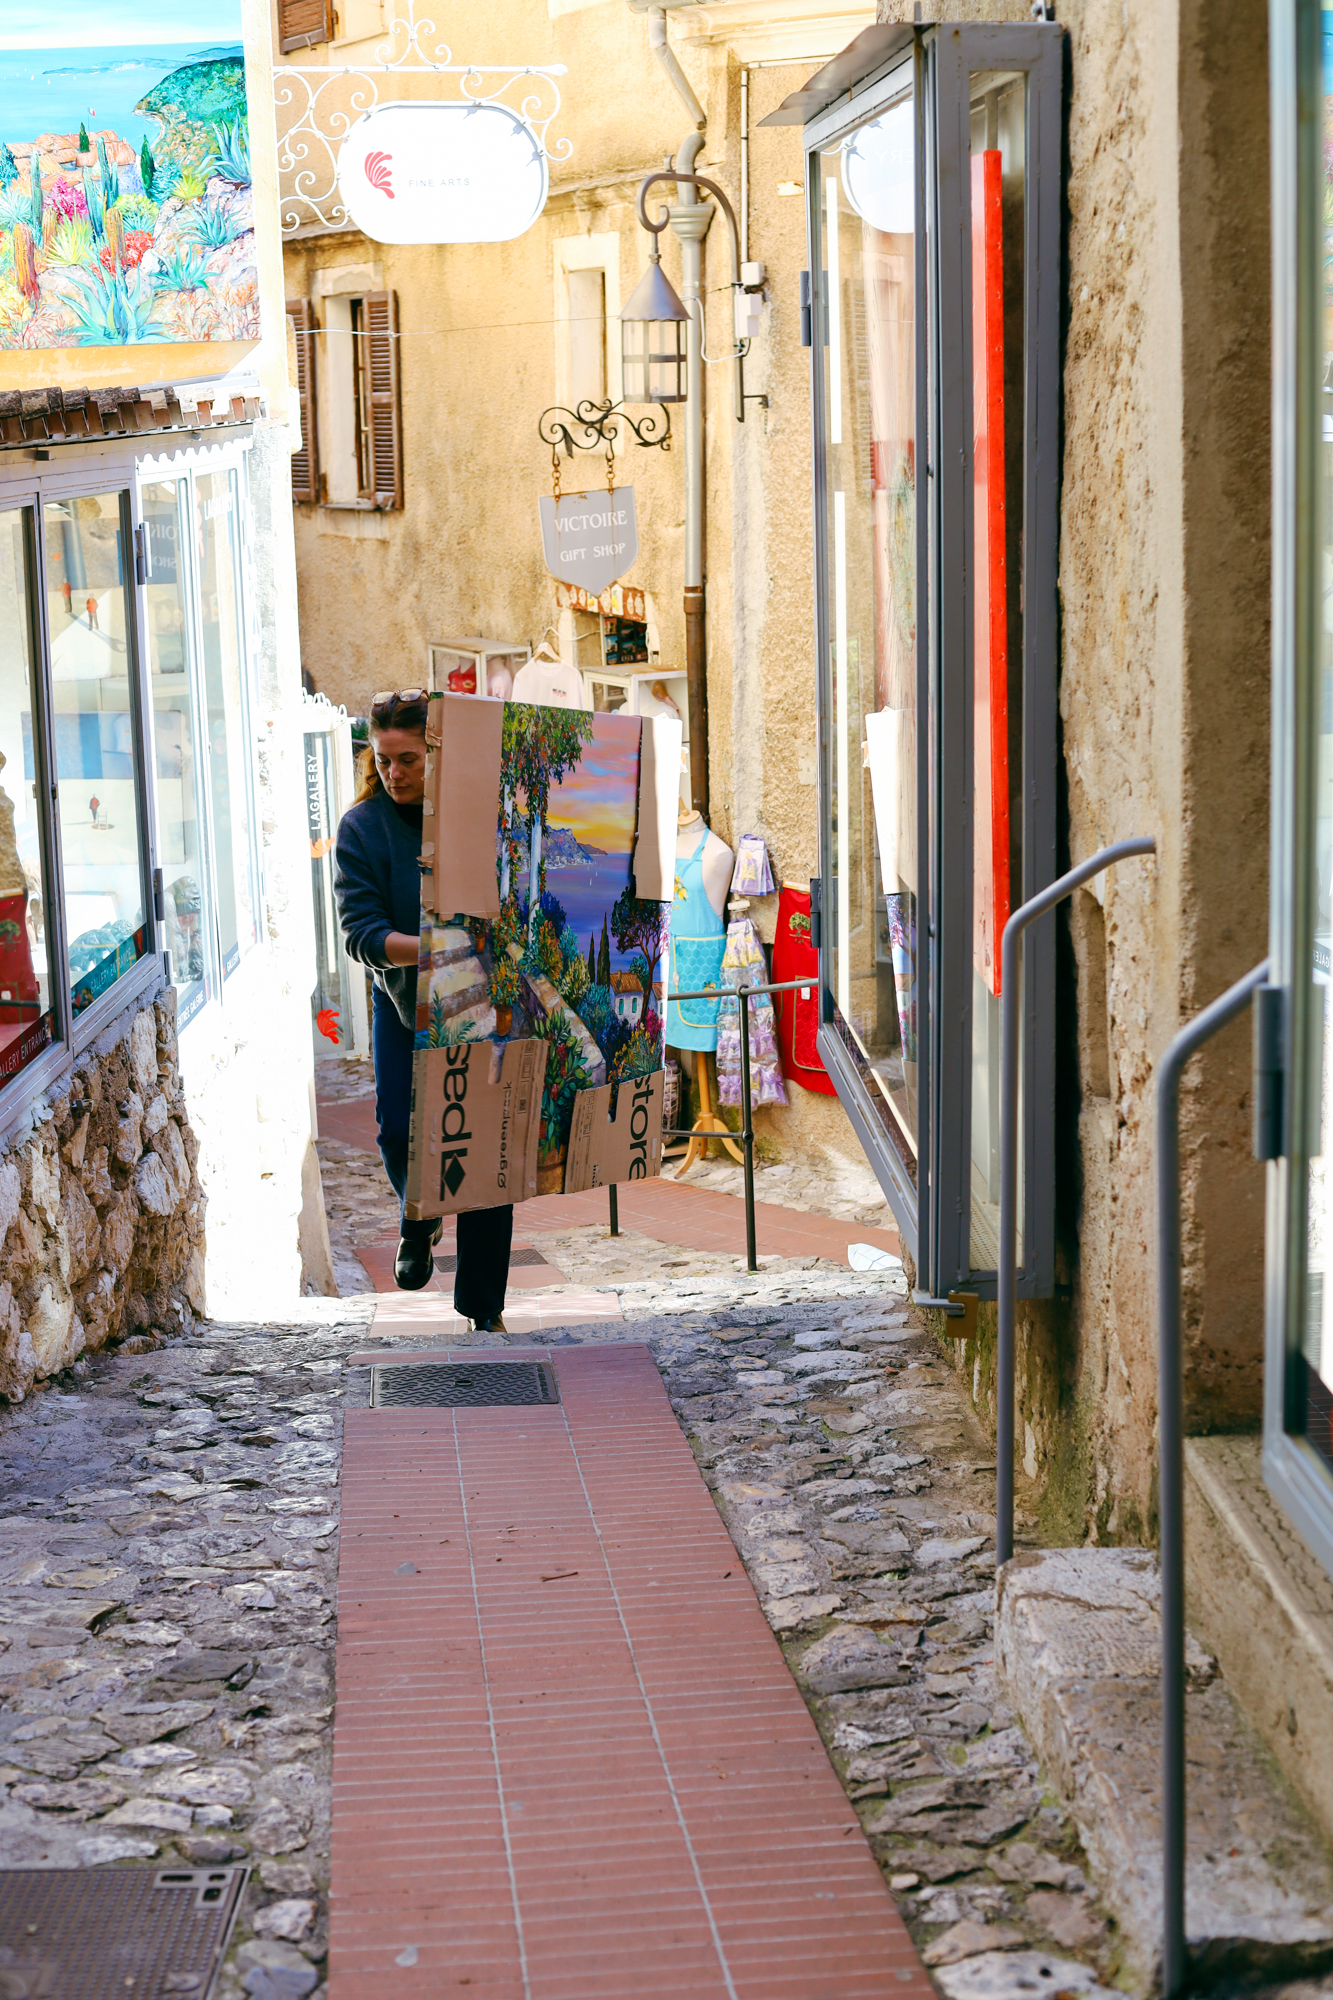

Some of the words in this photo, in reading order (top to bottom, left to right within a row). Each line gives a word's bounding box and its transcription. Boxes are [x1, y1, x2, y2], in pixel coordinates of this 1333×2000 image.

[408, 178, 435, 188] FINE
[439, 177, 471, 187] ARTS
[554, 510, 628, 532] VICTOIRE
[560, 548, 587, 562] GIFT
[593, 542, 626, 558] SHOP
[307, 754, 321, 830] LAGALERY
[90, 966, 109, 994] GALLERY
[21, 1024, 49, 1060] ENTRANCE
[498, 1081, 513, 1170] greenpack
